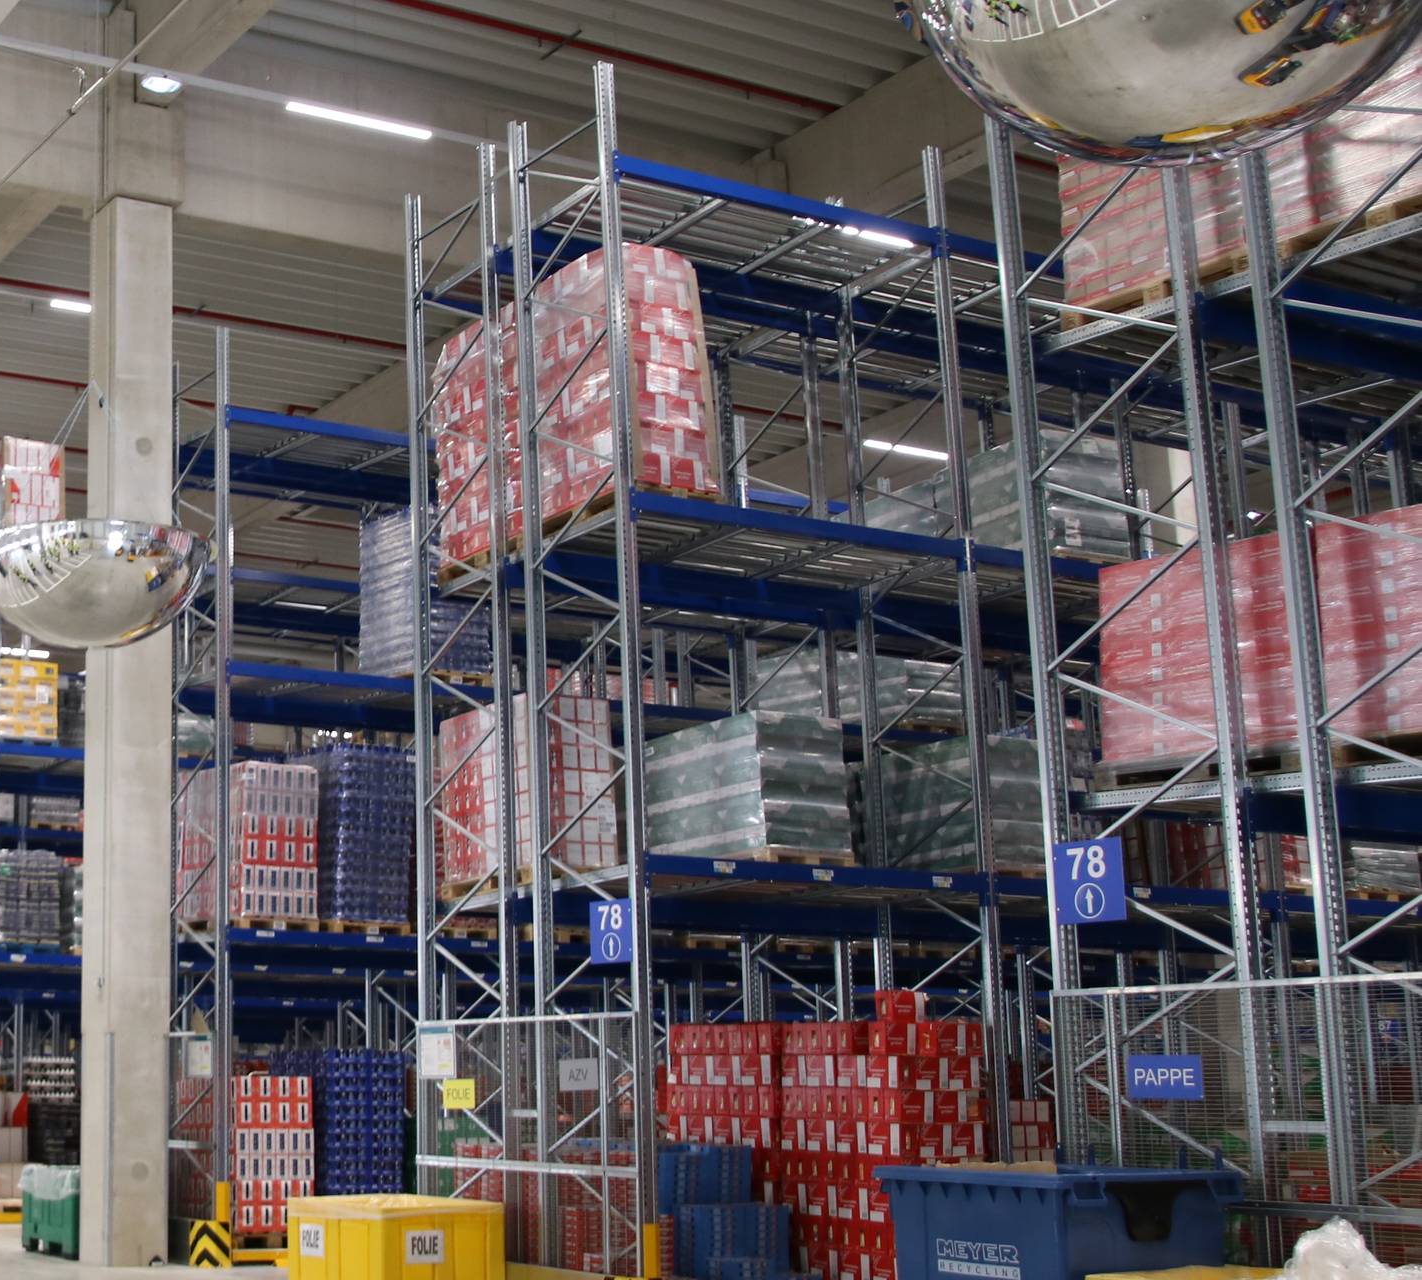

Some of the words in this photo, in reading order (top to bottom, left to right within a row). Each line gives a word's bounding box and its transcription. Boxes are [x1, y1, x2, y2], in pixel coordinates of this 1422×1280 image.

[1066, 845, 1106, 880] 78
[597, 903, 623, 931] 78
[568, 1068, 588, 1082] AZV
[1134, 1068, 1195, 1086] PAPPE
[446, 1087, 471, 1101] FOLIE
[302, 1229, 321, 1249] FOLIE
[411, 1235, 439, 1256] FOLIE
[936, 1238, 1020, 1264] MEYER
[939, 1261, 1020, 1278] RECYCLING
